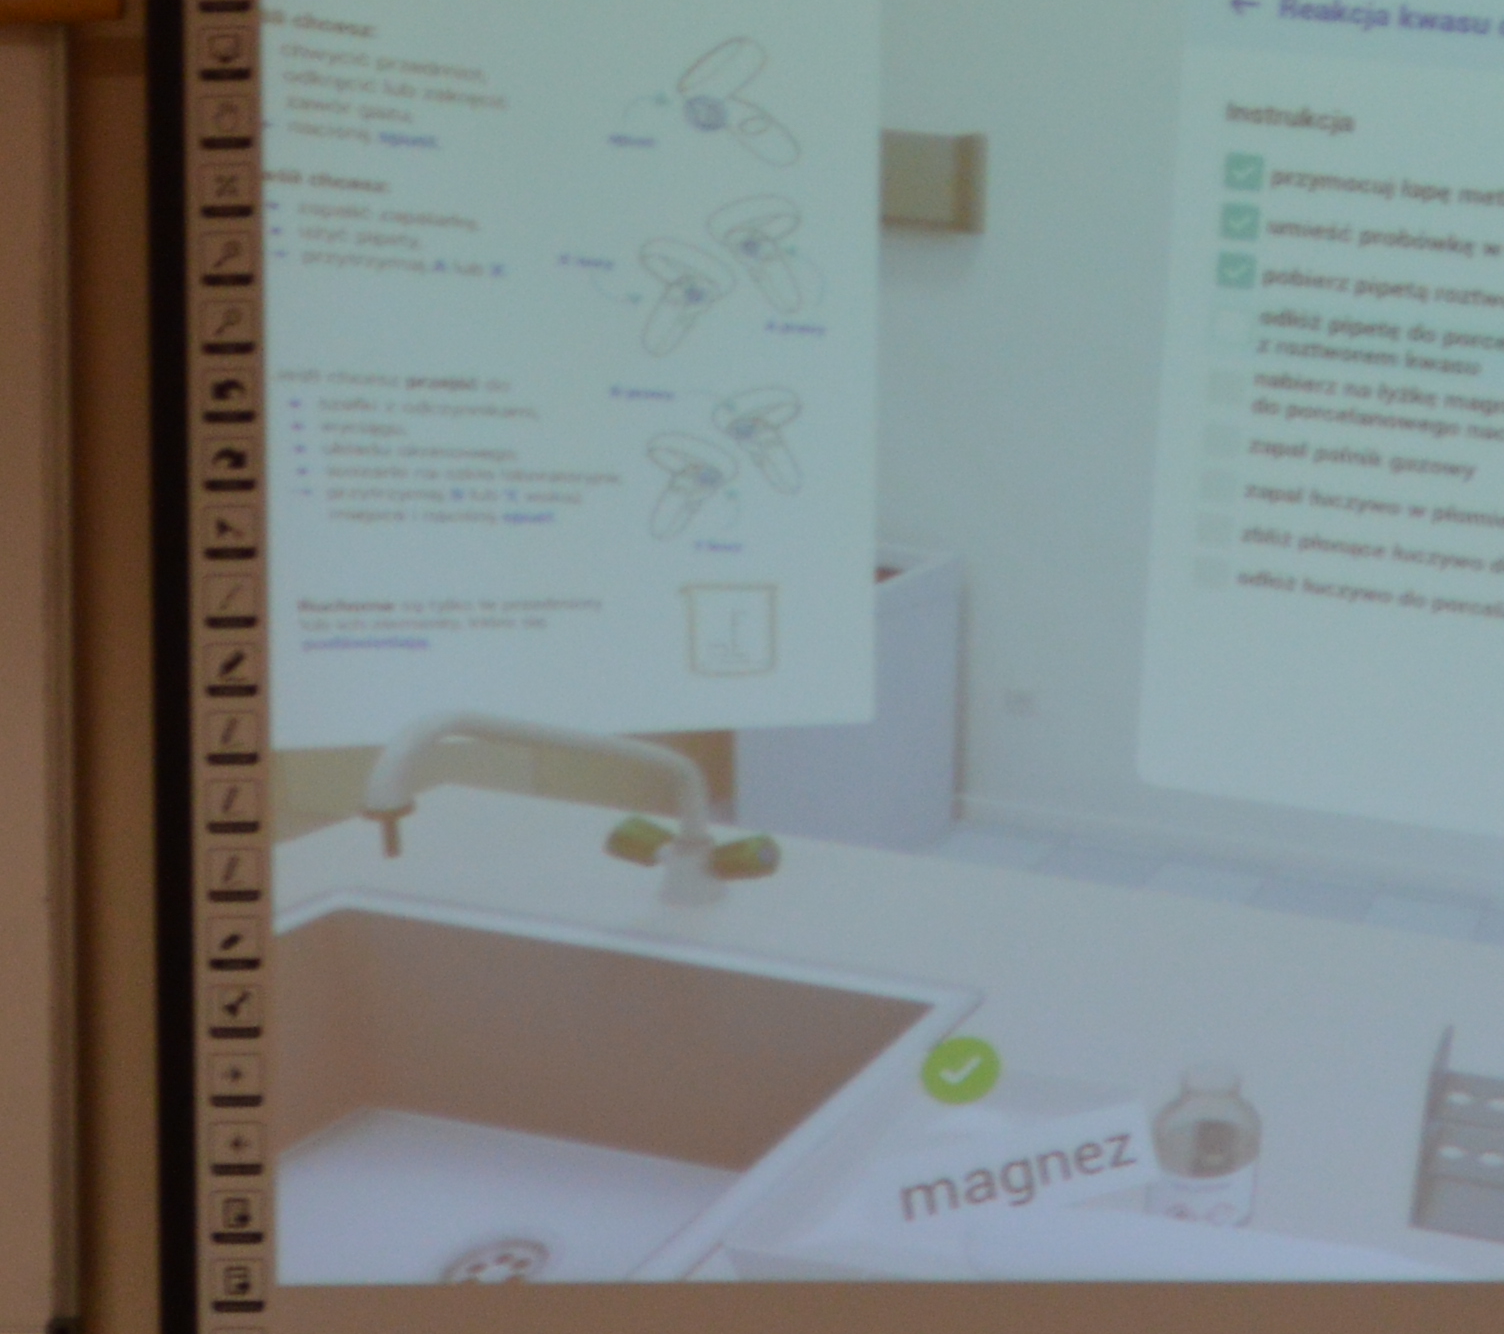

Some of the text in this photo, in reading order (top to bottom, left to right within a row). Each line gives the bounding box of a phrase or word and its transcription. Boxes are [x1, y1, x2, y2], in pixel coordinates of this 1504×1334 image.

[1397, 5, 1491, 36] kwasu
[1224, 102, 1356, 135] Instrukcja
[898, 1129, 1137, 1222] magnez
